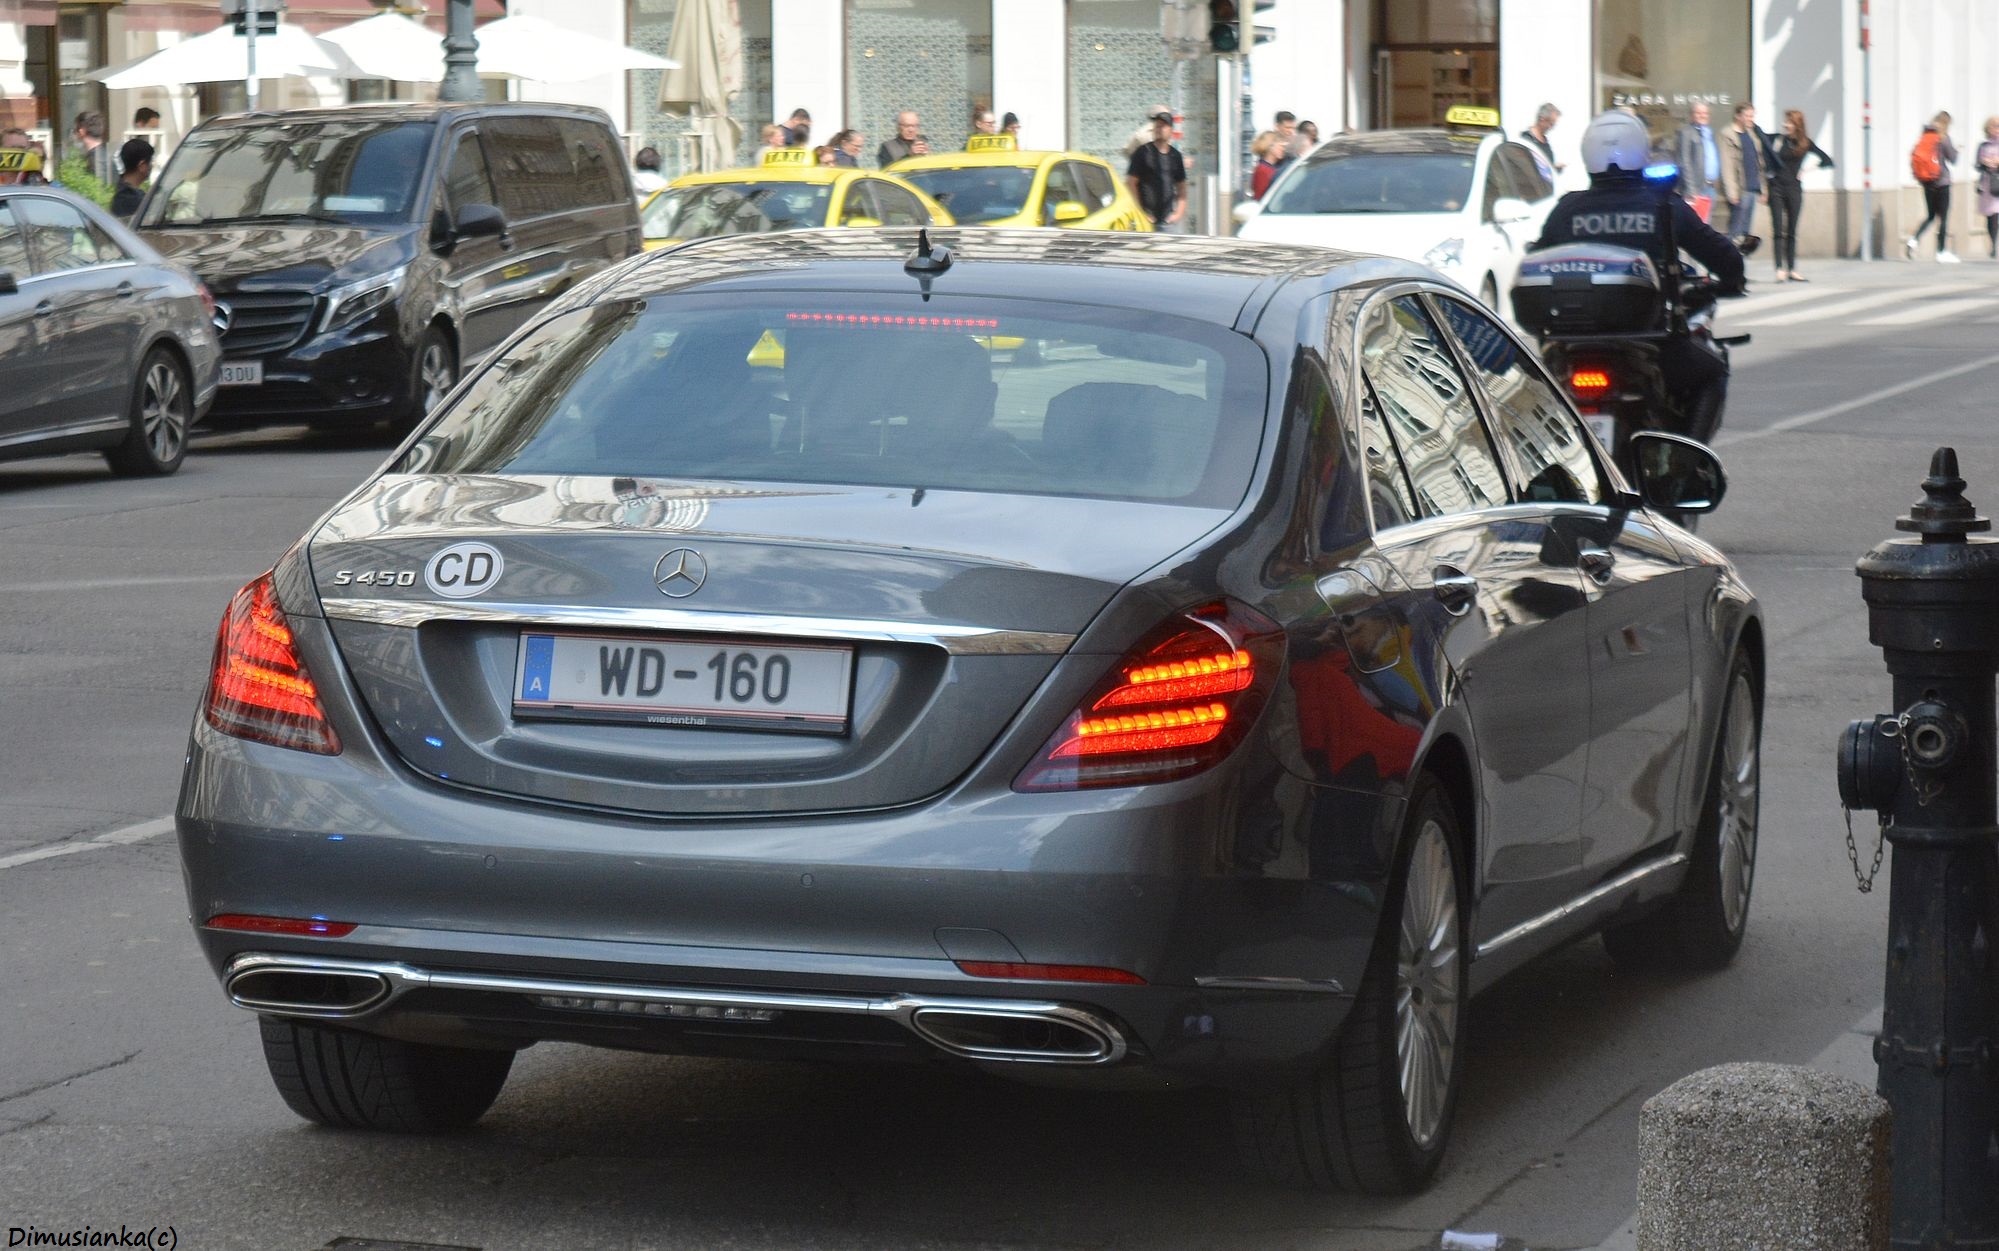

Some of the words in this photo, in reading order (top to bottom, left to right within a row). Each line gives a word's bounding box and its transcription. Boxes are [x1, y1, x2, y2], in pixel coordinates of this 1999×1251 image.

[1612, 92, 1667, 106] ZARA
[1673, 92, 1731, 105] HOME
[1454, 110, 1492, 122] TAXI
[972, 138, 1007, 149] TAXI
[766, 152, 804, 163] TAXI
[1571, 212, 1656, 236] POLIZEI
[1539, 261, 1606, 274] POLIZEI
[434, 552, 494, 588] CD
[333, 570, 353, 586] S
[356, 570, 416, 587] 450
[599, 645, 791, 705] WD-160
[529, 677, 543, 692] A
[647, 715, 707, 726] wiesenthal
